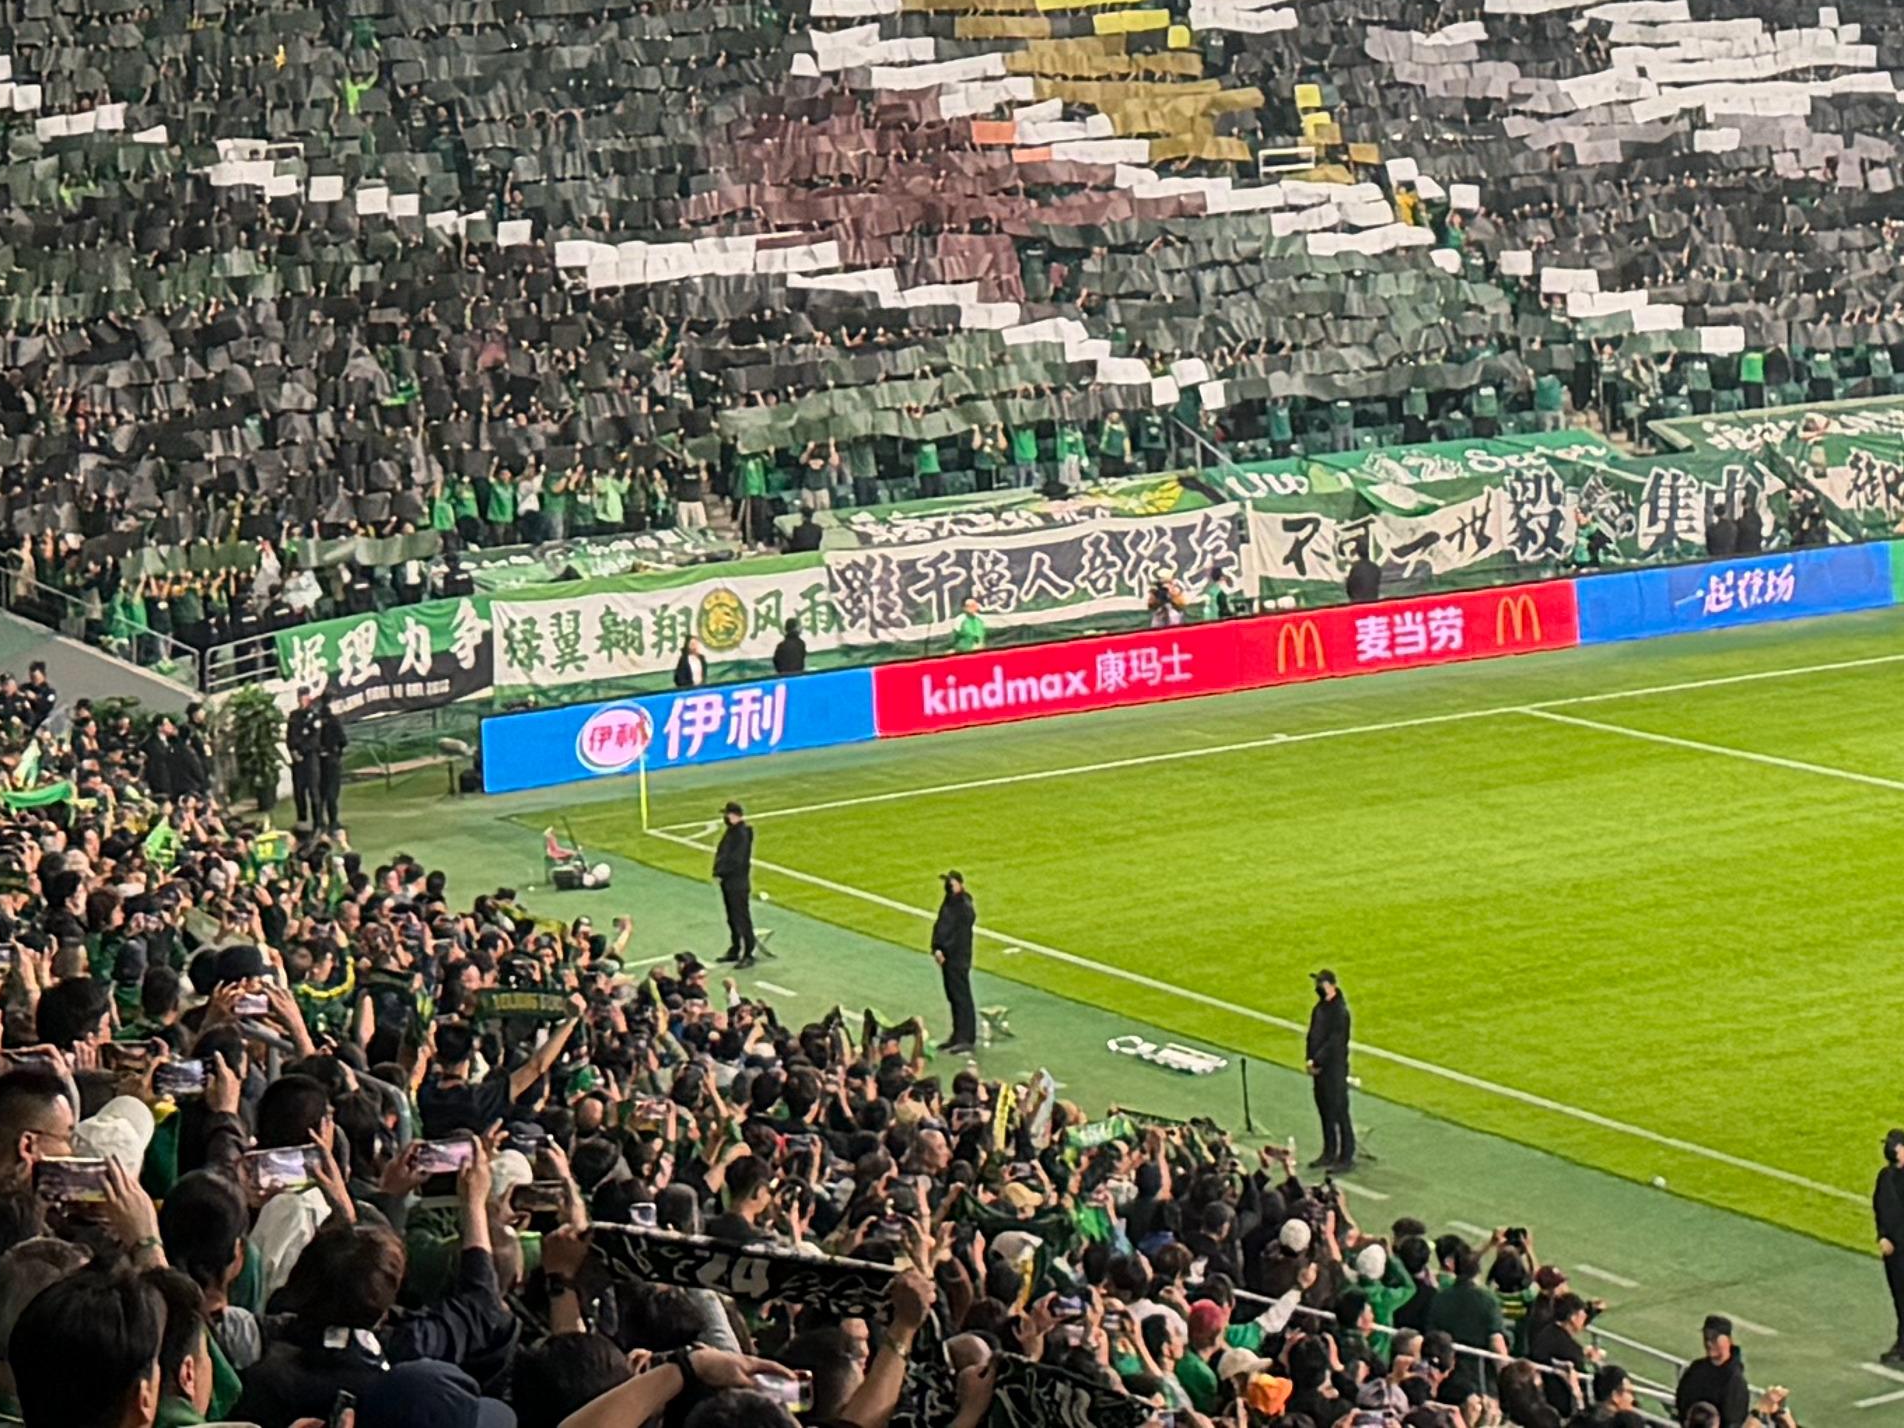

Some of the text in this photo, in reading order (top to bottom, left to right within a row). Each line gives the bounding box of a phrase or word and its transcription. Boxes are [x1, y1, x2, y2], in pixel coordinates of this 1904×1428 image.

[1353, 604, 1466, 664] 麦当劳
[921, 641, 1194, 717] kindmax 康玛士
[663, 682, 788, 761] 伊利
